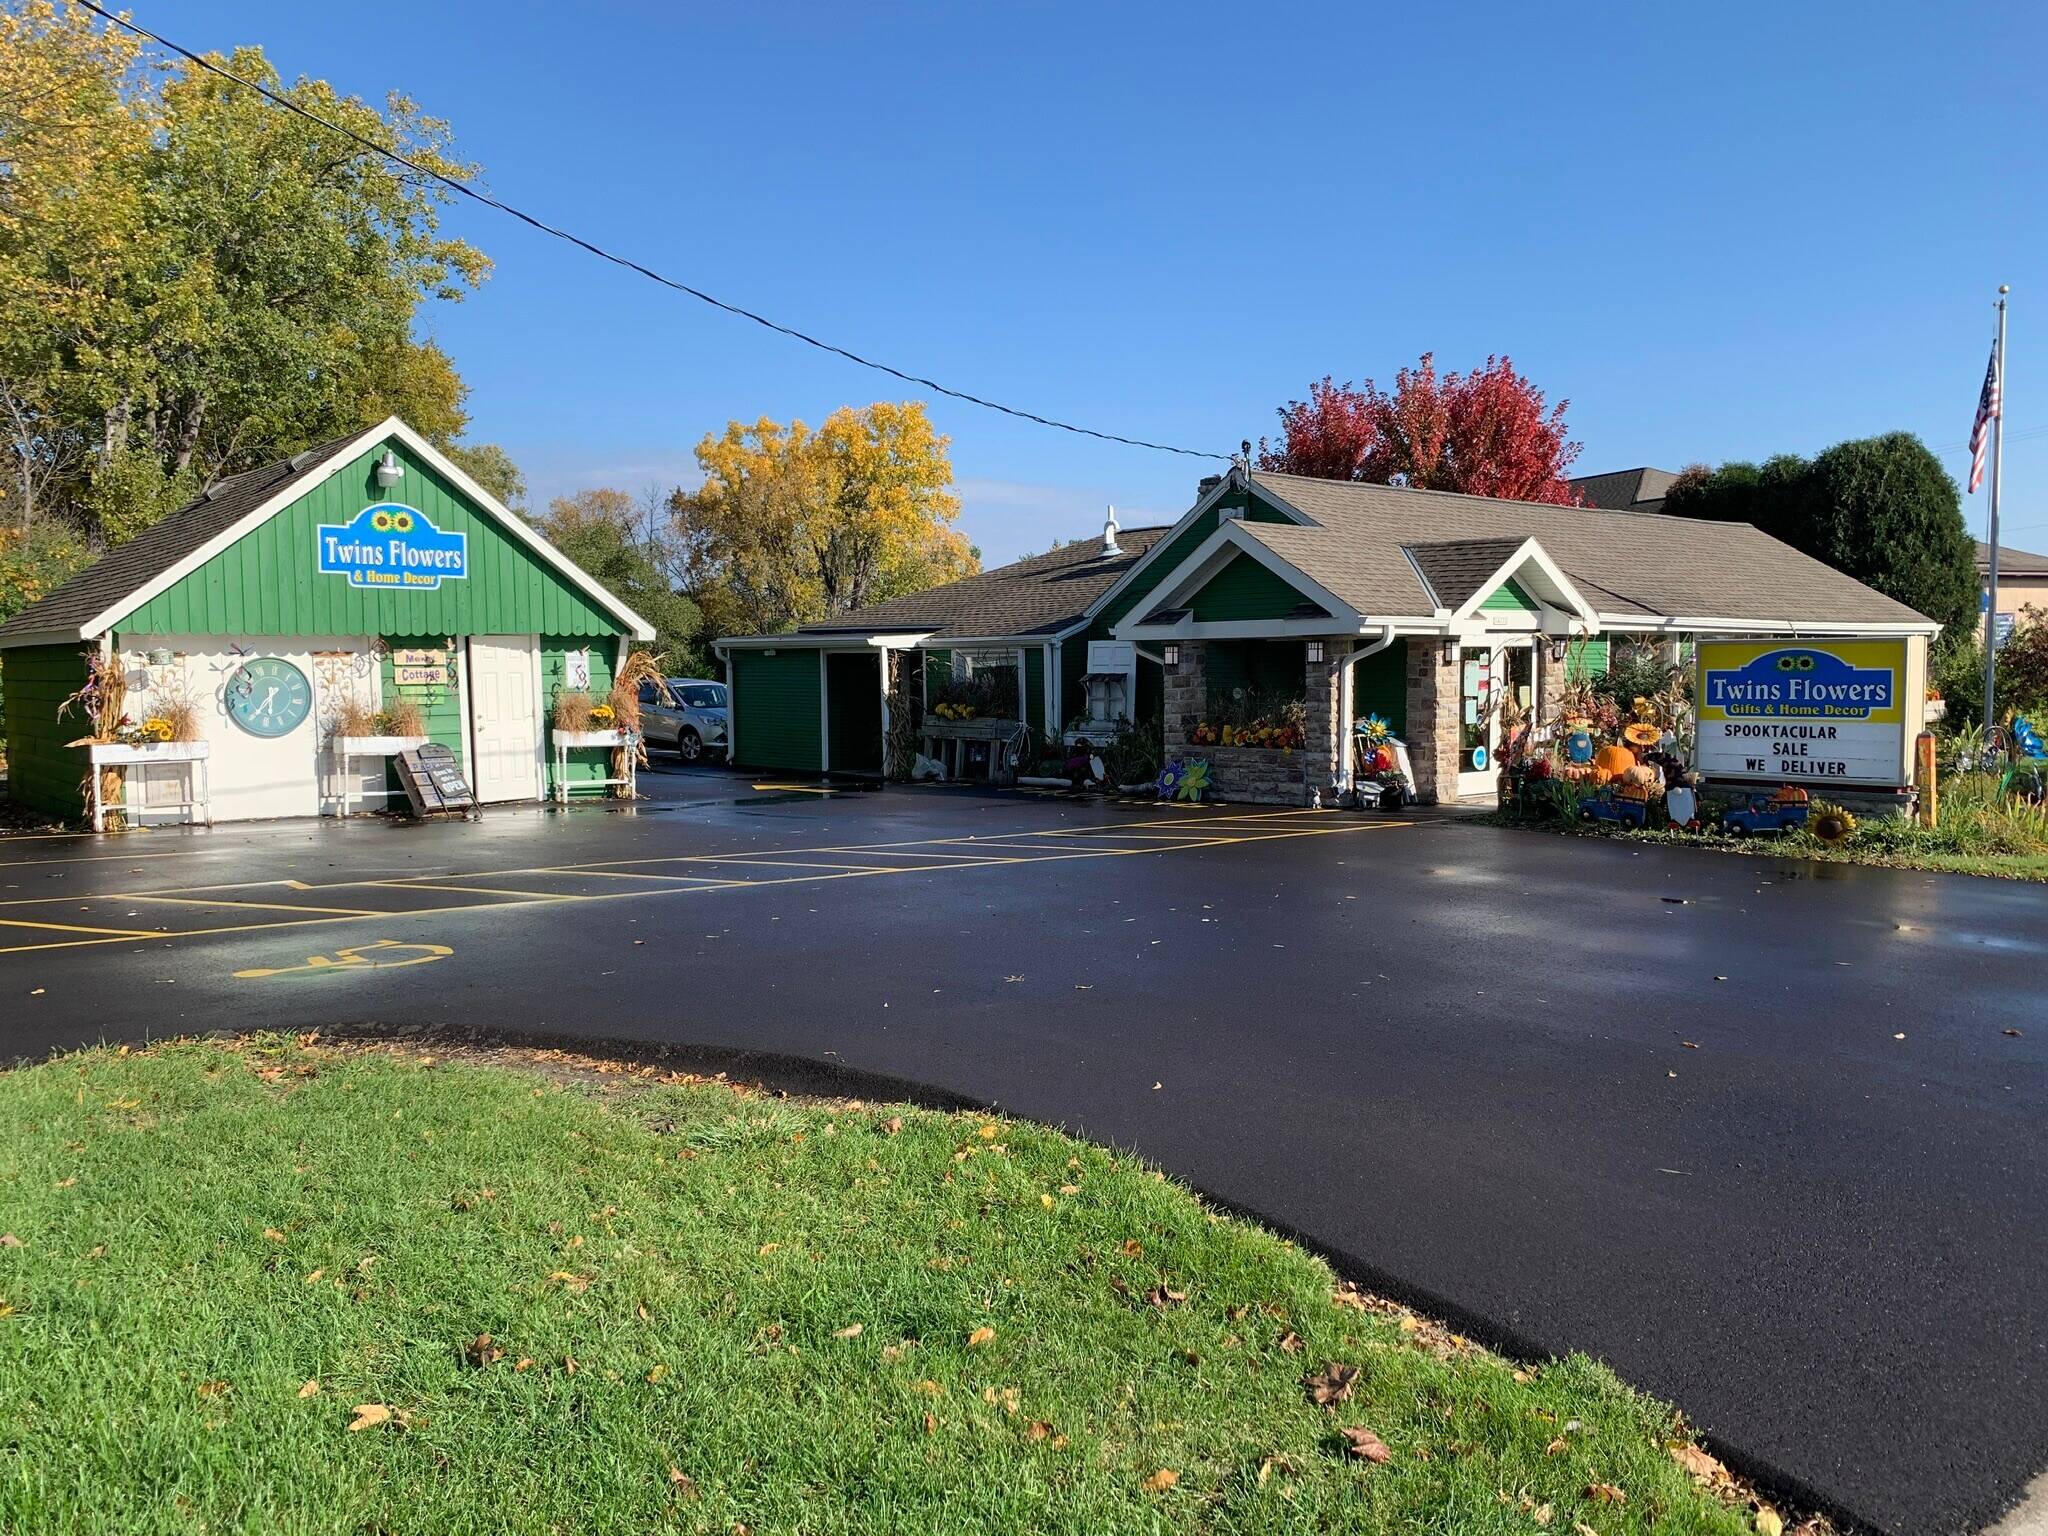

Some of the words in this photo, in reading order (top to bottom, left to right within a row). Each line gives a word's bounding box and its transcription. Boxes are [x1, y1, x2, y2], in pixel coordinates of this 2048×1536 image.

[325, 536, 384, 566] Twins
[389, 540, 462, 569] Flowers
[354, 570, 363, 583] &
[367, 570, 400, 583] Home
[404, 572, 436, 585] Decor
[402, 669, 440, 681] Cottage
[1713, 678, 1780, 700] Twins
[1788, 678, 1887, 701] Flowers
[1730, 703, 1761, 715] Gifts
[1764, 704, 1774, 715] &
[1779, 704, 1820, 715] Home
[1824, 704, 1866, 716] Decor
[1724, 724, 1837, 739] SPOOKTACULAR
[1772, 742, 1808, 756] SALE
[1746, 758, 1765, 771] WE
[1781, 760, 1846, 775] DELIVER
[442, 780, 467, 793] OPEN
